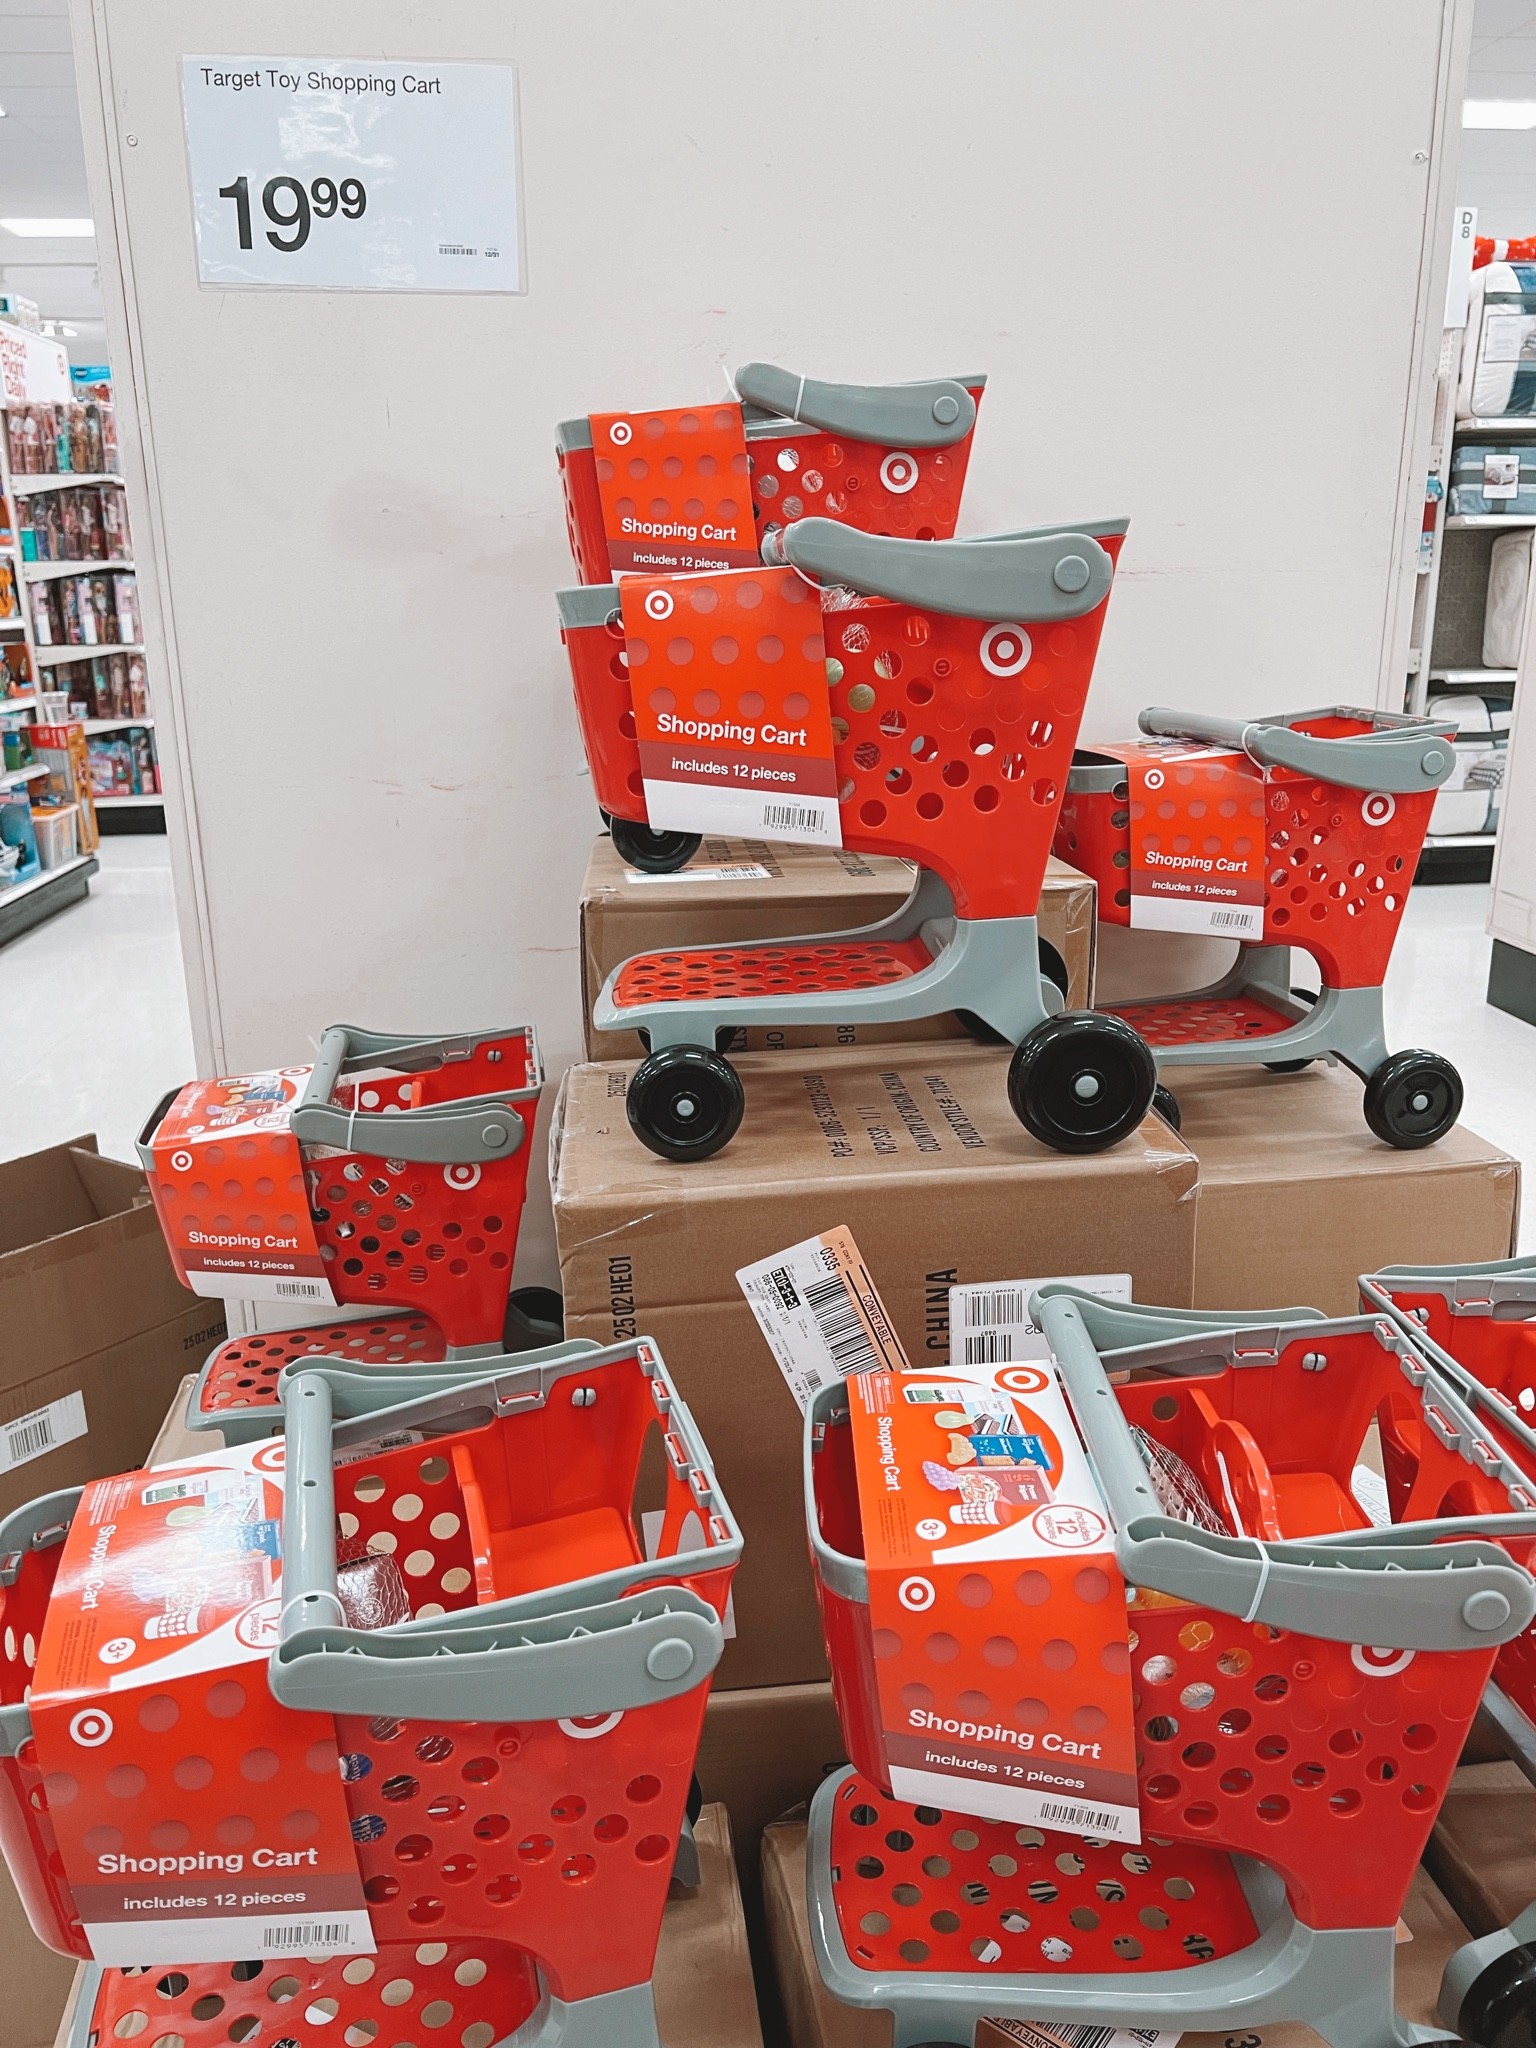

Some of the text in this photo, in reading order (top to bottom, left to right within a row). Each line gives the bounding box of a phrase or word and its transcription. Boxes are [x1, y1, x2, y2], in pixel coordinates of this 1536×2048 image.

[200, 68, 442, 96] Target Toy Shopping Cart
[1462, 212, 1473, 225] D
[1461, 226, 1470, 239] 8
[621, 517, 737, 541] Shopping Cart
[633, 552, 730, 570] includes 12 pieces
[657, 713, 808, 747] Shopping Cart
[671, 757, 797, 783] includes 12 pieces
[1144, 850, 1248, 873] Shopping Cart
[1151, 880, 1238, 897] includes 12 pieces
[188, 1231, 298, 1249] Shopping Cart
[203, 1257, 295, 1270] includes 12 pieces
[820, 1246, 841, 1271] 0335
[608, 1256, 637, 1339] 2502HE01
[925, 1267, 958, 1350] CHINA
[862, 1294, 892, 1345] CONVEYABLE
[877, 1416, 896, 1470] Shopping
[883, 1467, 901, 1491] Cart
[921, 1522, 938, 1537] 3+
[1041, 1514, 1057, 1540] pieces
[1057, 1517, 1079, 1535] 12
[1074, 1510, 1091, 1543] includes
[85, 1524, 117, 1579] Shopping
[80, 1577, 105, 1611] Cart
[249, 1611, 260, 1642] pieces
[107, 1641, 128, 1660] 3+
[907, 1708, 1102, 1760] Shopping Cart
[925, 1750, 1086, 1790] includes 12 pieces
[97, 1847, 319, 1876] Shopping Cart
[123, 1890, 307, 1910] includes 12 pieces
[308, 1940, 339, 1948] 71304
